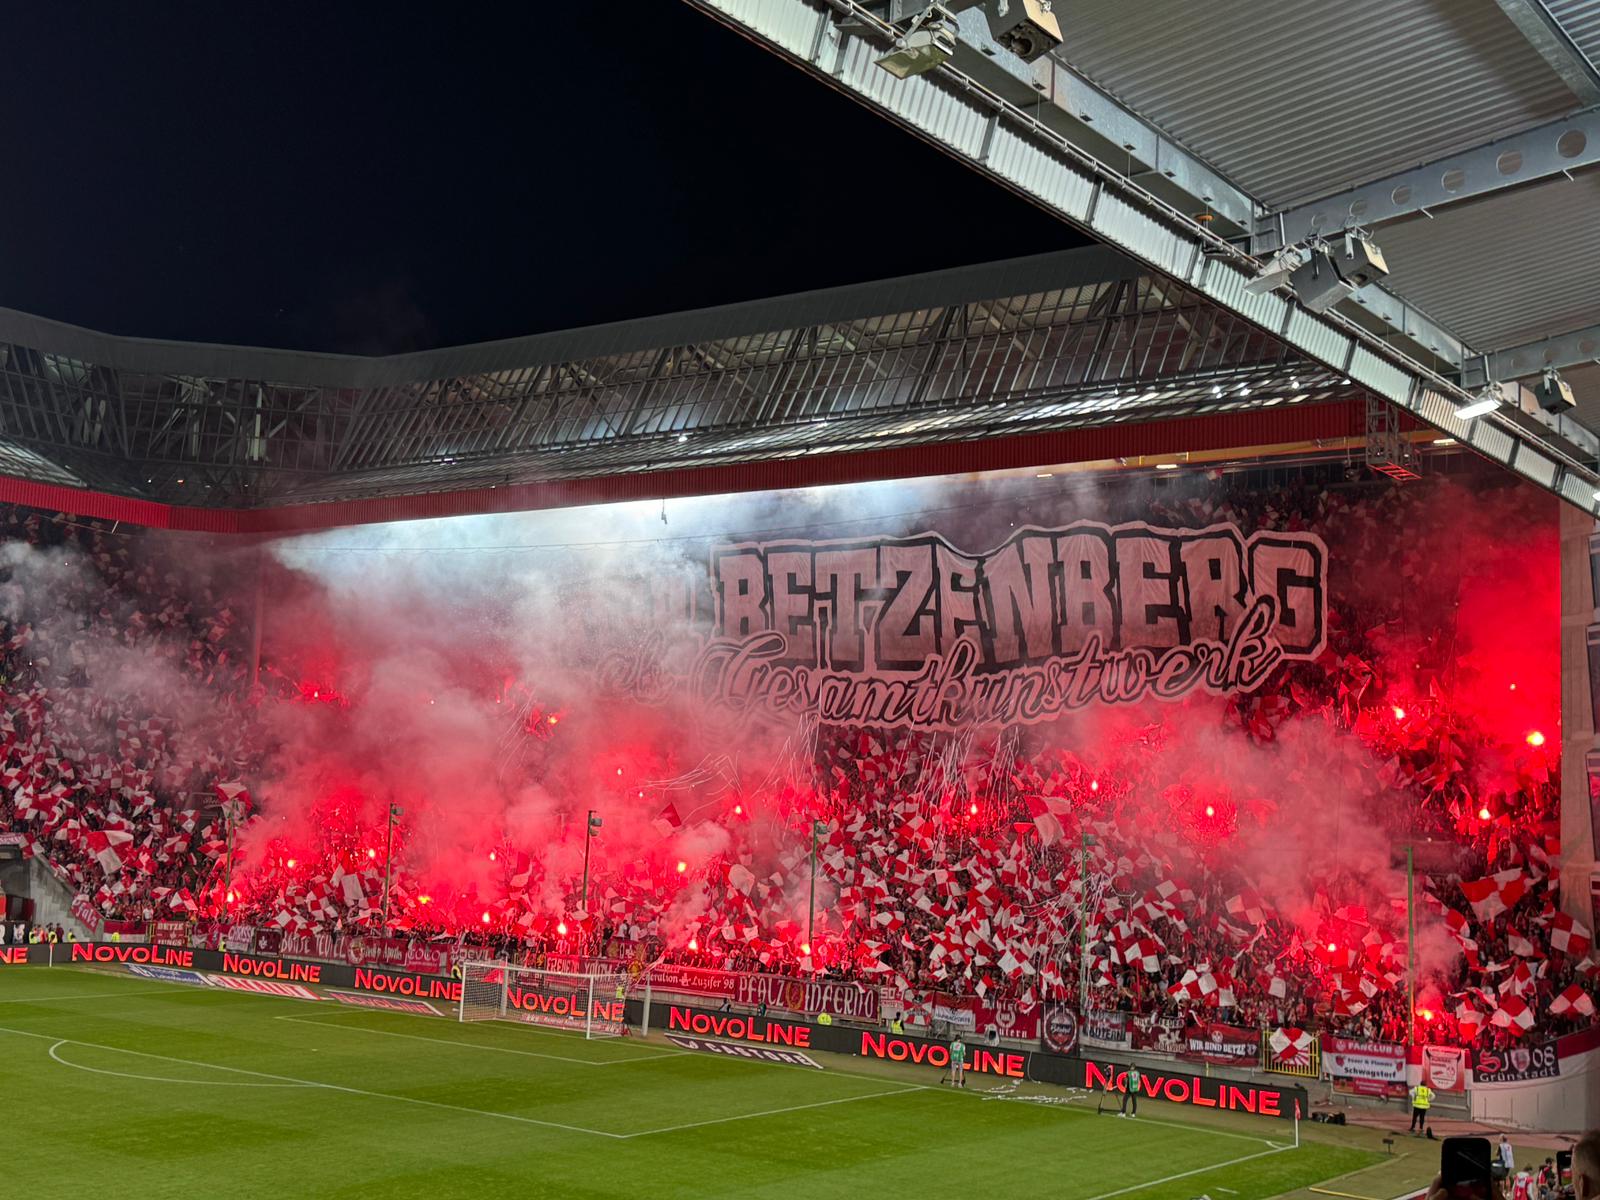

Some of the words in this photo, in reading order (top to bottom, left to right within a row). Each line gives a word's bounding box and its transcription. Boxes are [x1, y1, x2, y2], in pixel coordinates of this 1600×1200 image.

[714, 522, 1327, 668] BETZENBERG
[691, 976, 721, 989] Luzifer
[739, 976, 785, 1007] PFALZ
[504, 986, 625, 1023] NOVOLNE
[705, 1042, 812, 1066] CASTORE
[1189, 1039, 1203, 1051] WIR
[1347, 1043, 1393, 1054] FANCLUB
[1532, 1046, 1556, 1068] 08
[1344, 1066, 1397, 1078] Schwagstorf
[1479, 1067, 1556, 1083] Grünstadt
